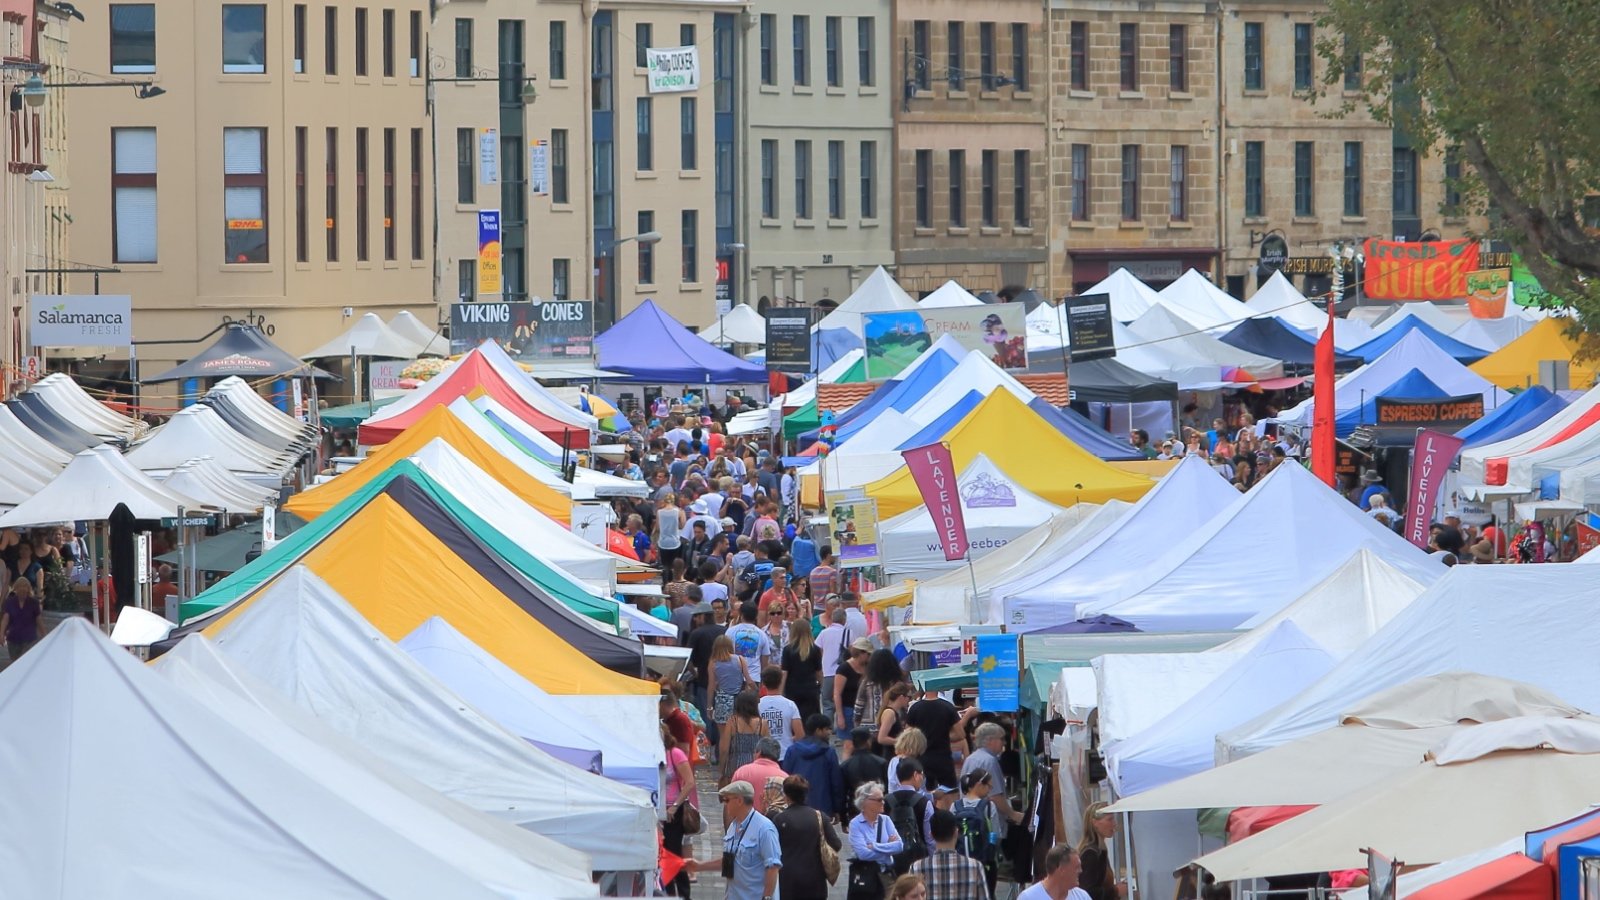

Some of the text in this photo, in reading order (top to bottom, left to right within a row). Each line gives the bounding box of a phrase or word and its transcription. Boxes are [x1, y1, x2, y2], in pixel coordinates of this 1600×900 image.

[1369, 240, 1437, 258] fresh
[1373, 258, 1467, 298] JUICE
[38, 310, 122, 324] Salamanca
[460, 302, 584, 323] VIKING CONES
[81, 325, 121, 335] FRESH
[923, 318, 971, 334] CREAM
[203, 360, 235, 368] JAMES
[380, 365, 393, 377] ICE
[1381, 402, 1482, 423] ESPRESSO COFFEE
[1413, 437, 1437, 542] LAVENDER
[926, 450, 960, 554] LAVENDER
